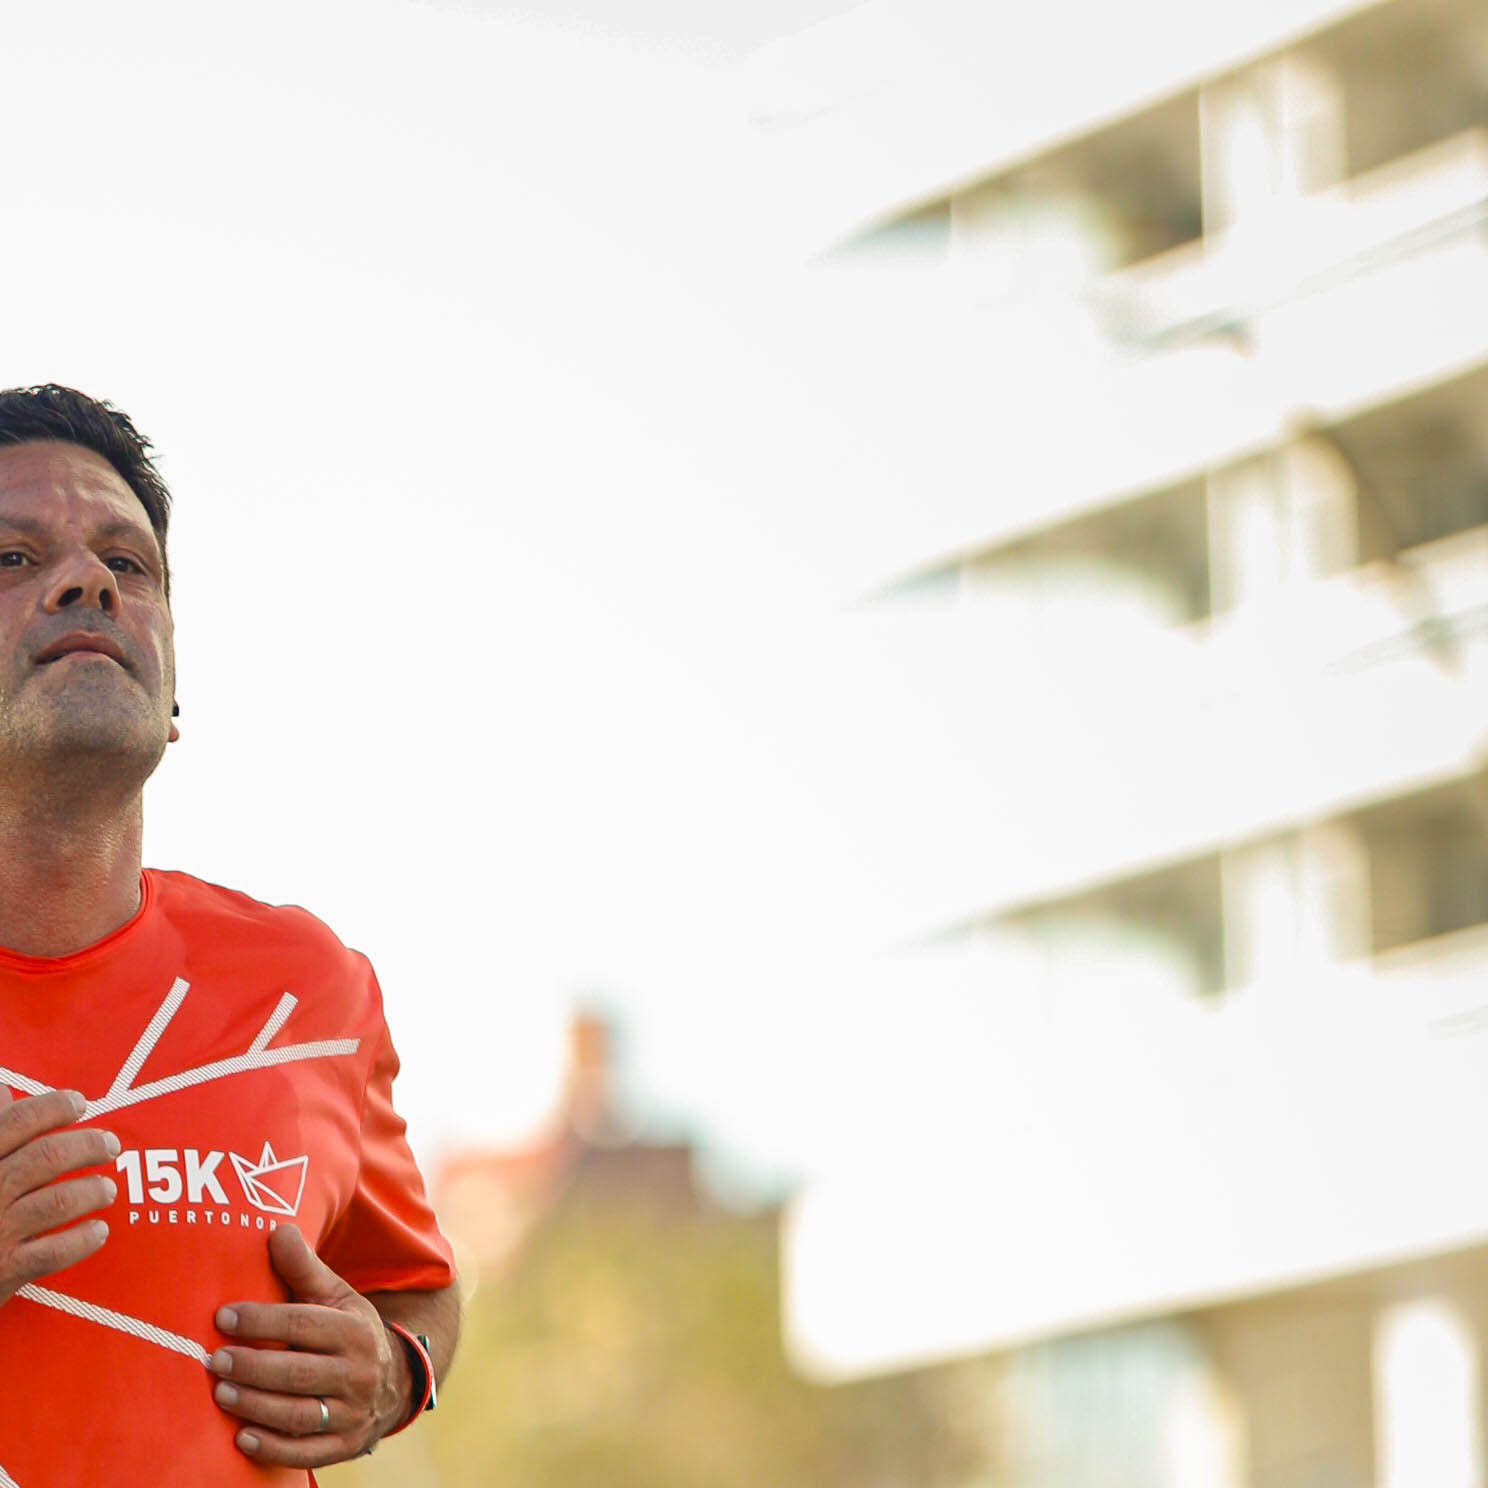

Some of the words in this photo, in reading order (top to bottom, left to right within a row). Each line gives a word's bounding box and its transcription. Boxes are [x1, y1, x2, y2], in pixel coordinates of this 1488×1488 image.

[116, 1149, 230, 1205] 15K
[129, 1210, 232, 1225] PUERTO
[240, 1213, 278, 1231] NOR
